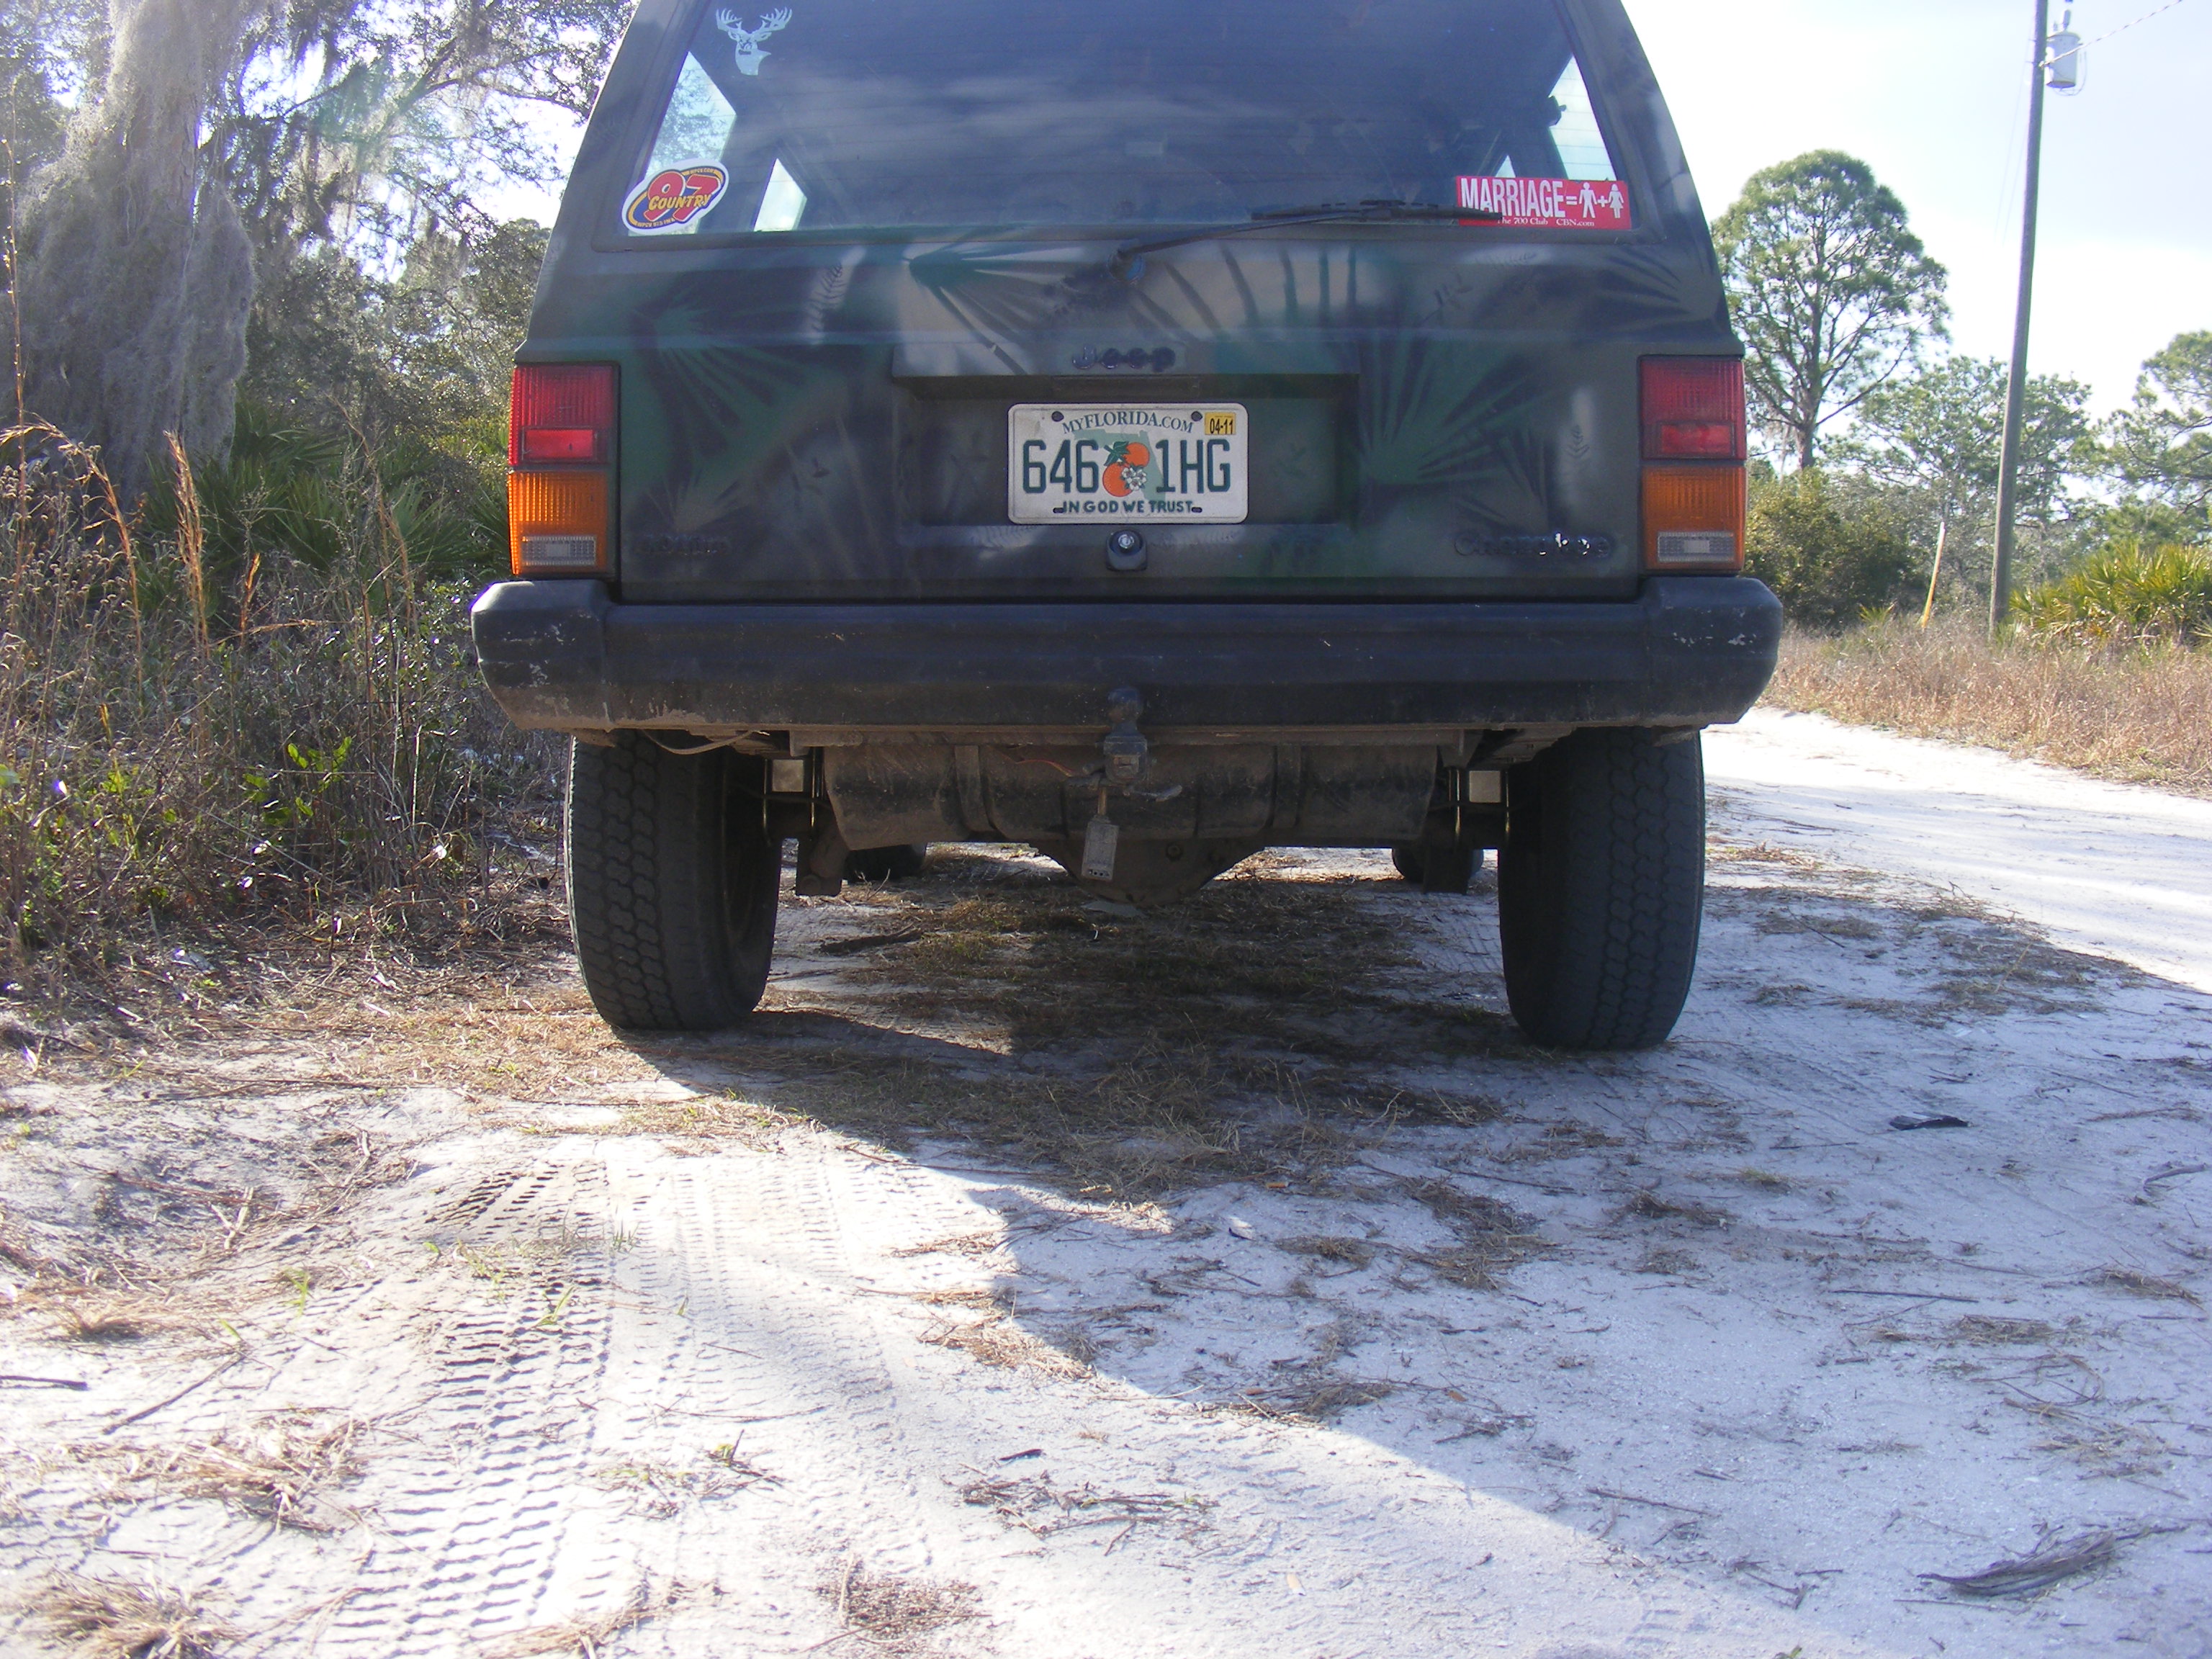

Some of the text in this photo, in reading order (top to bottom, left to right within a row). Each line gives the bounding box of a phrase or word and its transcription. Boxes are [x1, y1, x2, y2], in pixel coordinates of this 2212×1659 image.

[643, 171, 721, 222] 97
[648, 194, 712, 211] COUNTRY
[1529, 217, 1549, 225] Club
[1556, 217, 1596, 227] CBN.com
[1063, 411, 1195, 433] MYFLORIDA.COM
[1022, 439, 1231, 494] 646 1HG
[1062, 500, 1193, 513] IN GOD WE TRUST
